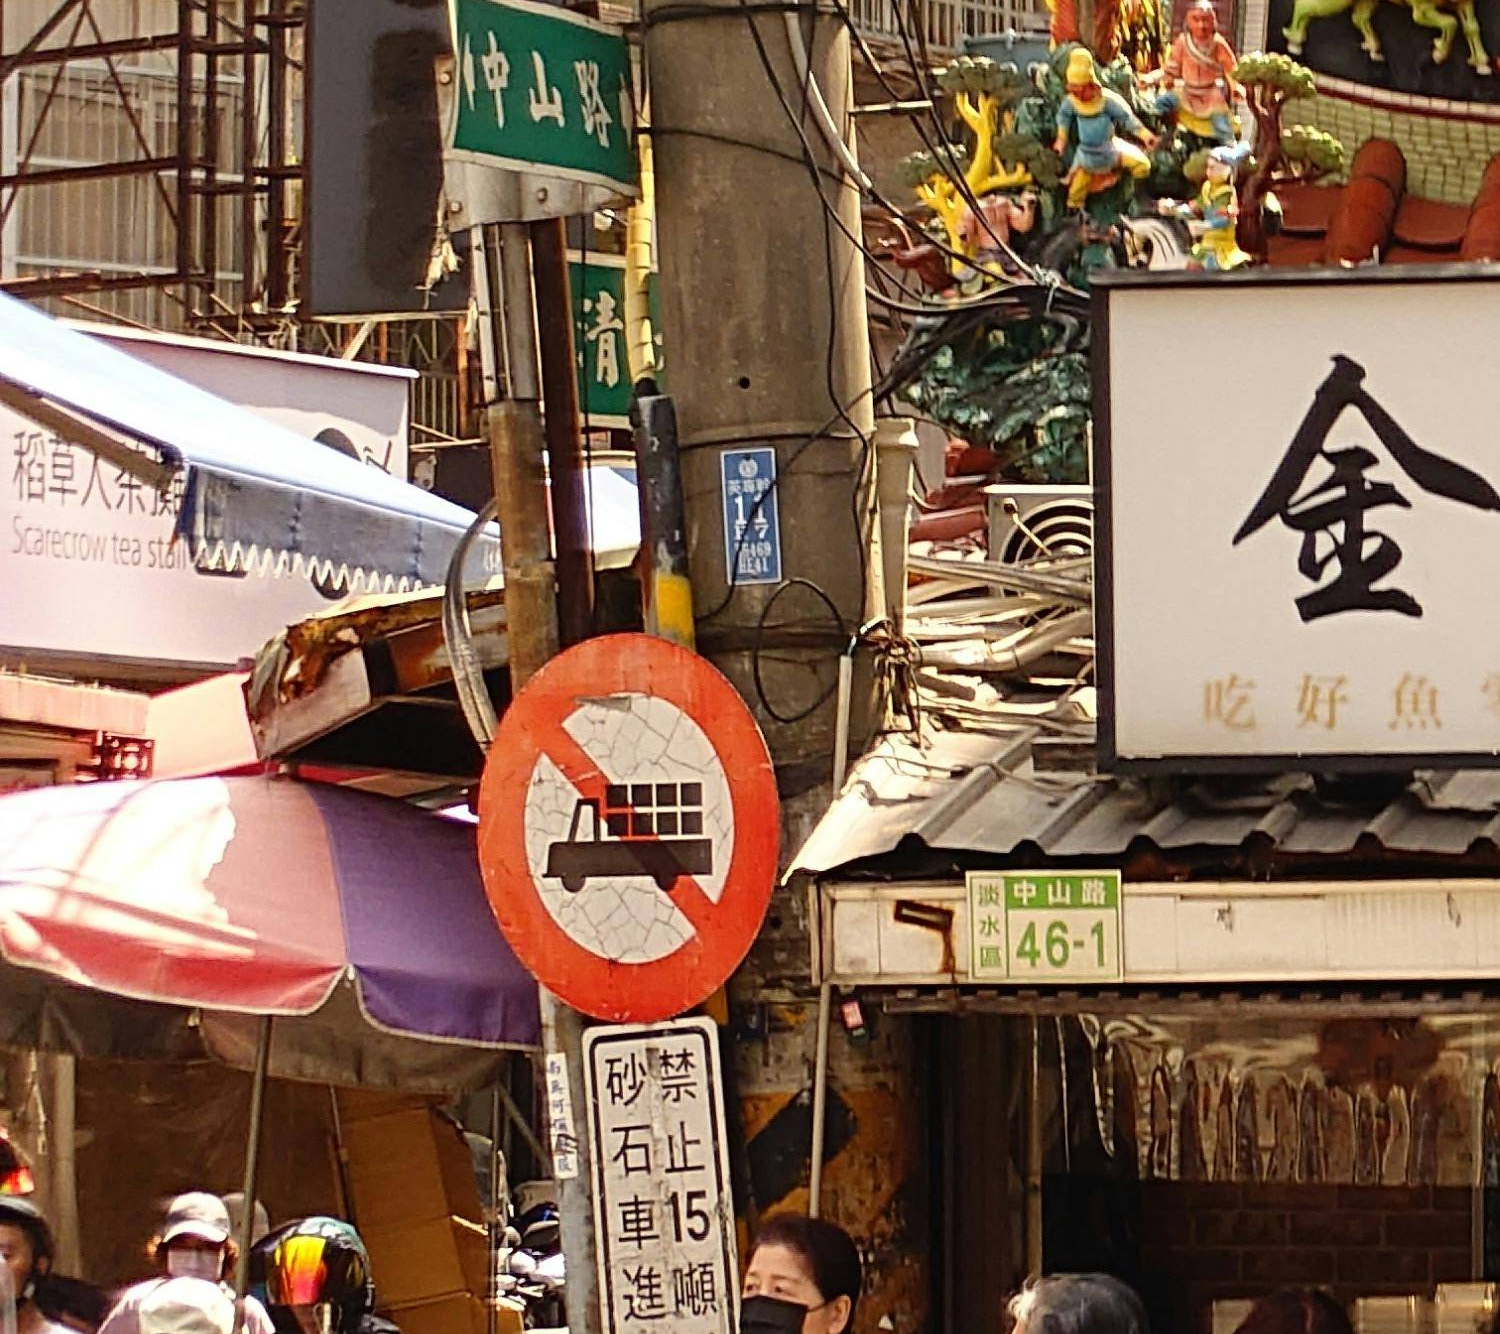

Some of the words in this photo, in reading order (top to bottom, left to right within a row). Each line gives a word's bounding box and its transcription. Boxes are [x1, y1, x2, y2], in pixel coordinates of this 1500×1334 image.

[481, 30, 612, 149] 中山路
[12, 515, 106, 562] Scarecrow
[112, 532, 142, 567] tea
[1013, 878, 1106, 906] 中山路
[1015, 919, 1105, 968] 46-1
